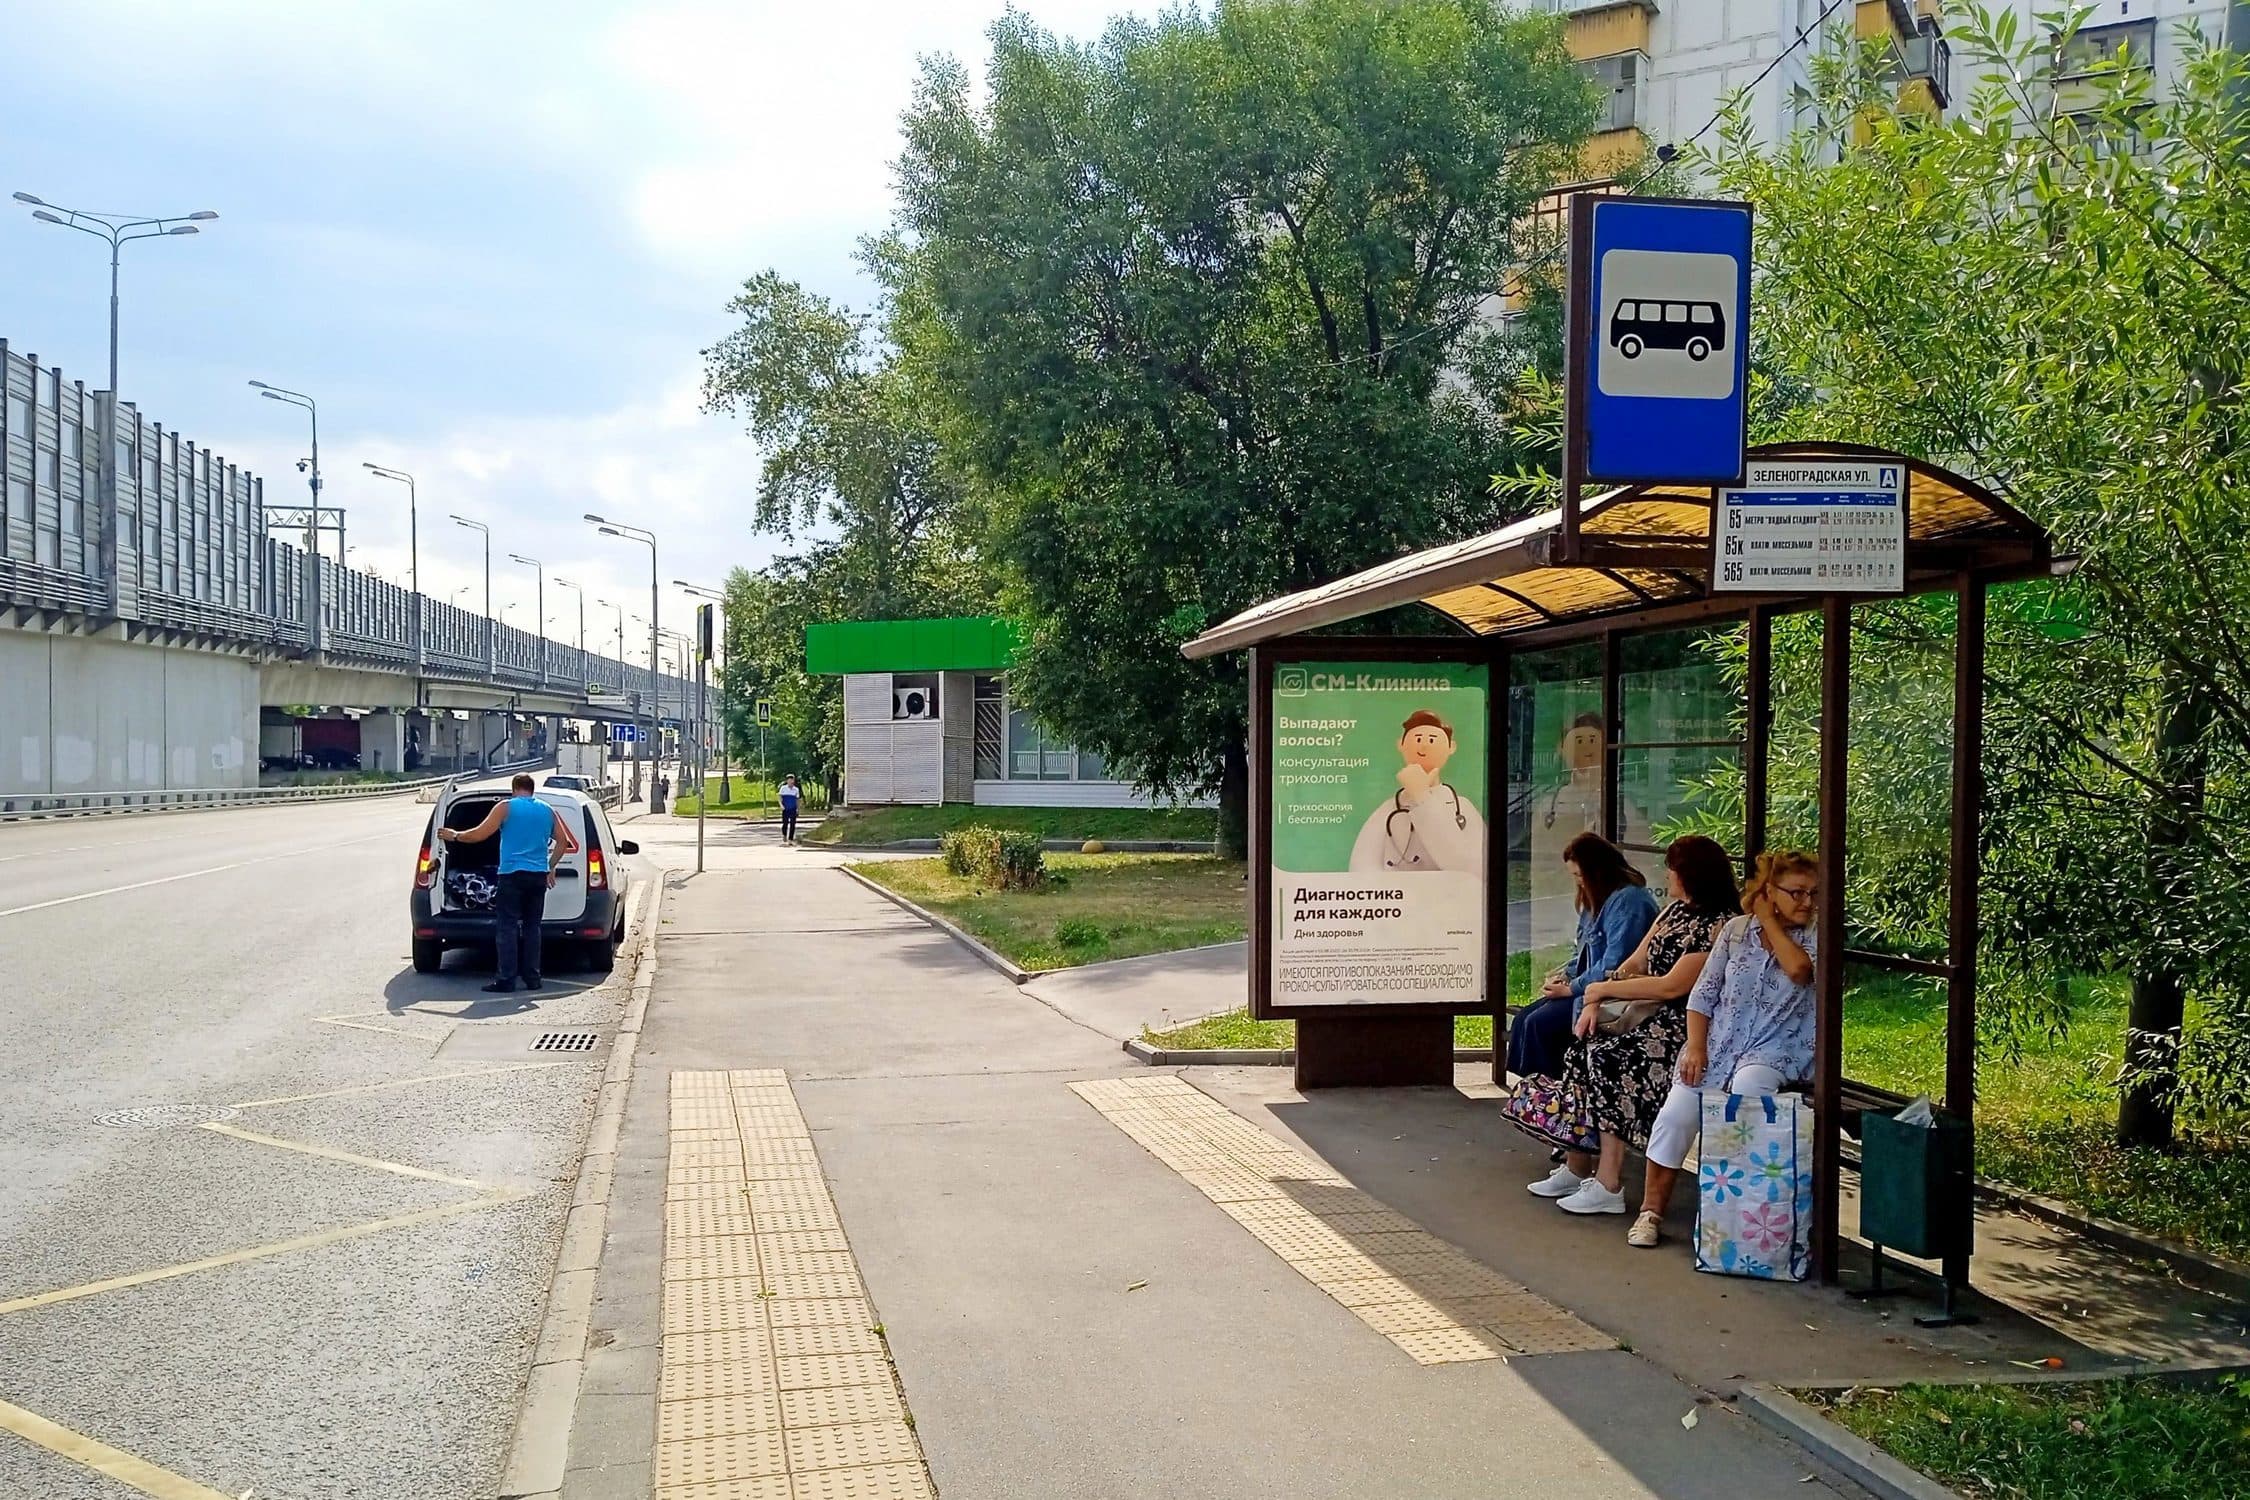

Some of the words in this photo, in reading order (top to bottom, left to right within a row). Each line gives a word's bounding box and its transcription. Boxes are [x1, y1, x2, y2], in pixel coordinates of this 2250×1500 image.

[1754, 470, 1851, 482] ЗЕЛЕНОГРАДСКАЯ
[1855, 471, 1871, 482] УЛ.
[1729, 509, 1742, 529] 65
[1745, 516, 1764, 525] МЕТРО
[1724, 562, 1743, 582] 565
[1311, 673, 1451, 691] СМ-Клиника
[1279, 716, 1357, 731] Выпадают
[1279, 734, 1343, 746] волосы?
[1279, 756, 1369, 769] консультация
[1279, 773, 1348, 786] трихолога
[1288, 802, 1353, 813] трихоскопия
[1294, 887, 1404, 904] Диагностика
[1294, 909, 1325, 922] для
[1329, 906, 1401, 921] каждого
[1294, 929, 1315, 939] Дни
[1316, 929, 1364, 940] здоровья
[1279, 966, 1321, 979] ИМЕЮТСЯ
[1322, 964, 1414, 979] ПРОТИВОПОКАЗАНИЯ
[1415, 963, 1473, 977] НЕОБХОДИМО
[1279, 978, 1388, 993] ПРОКОНСУЛЬТИРОВАТЬСЯ
[1389, 978, 1401, 990] СО
[1401, 976, 1473, 991] СПЕЦИАЛИСТОМ
